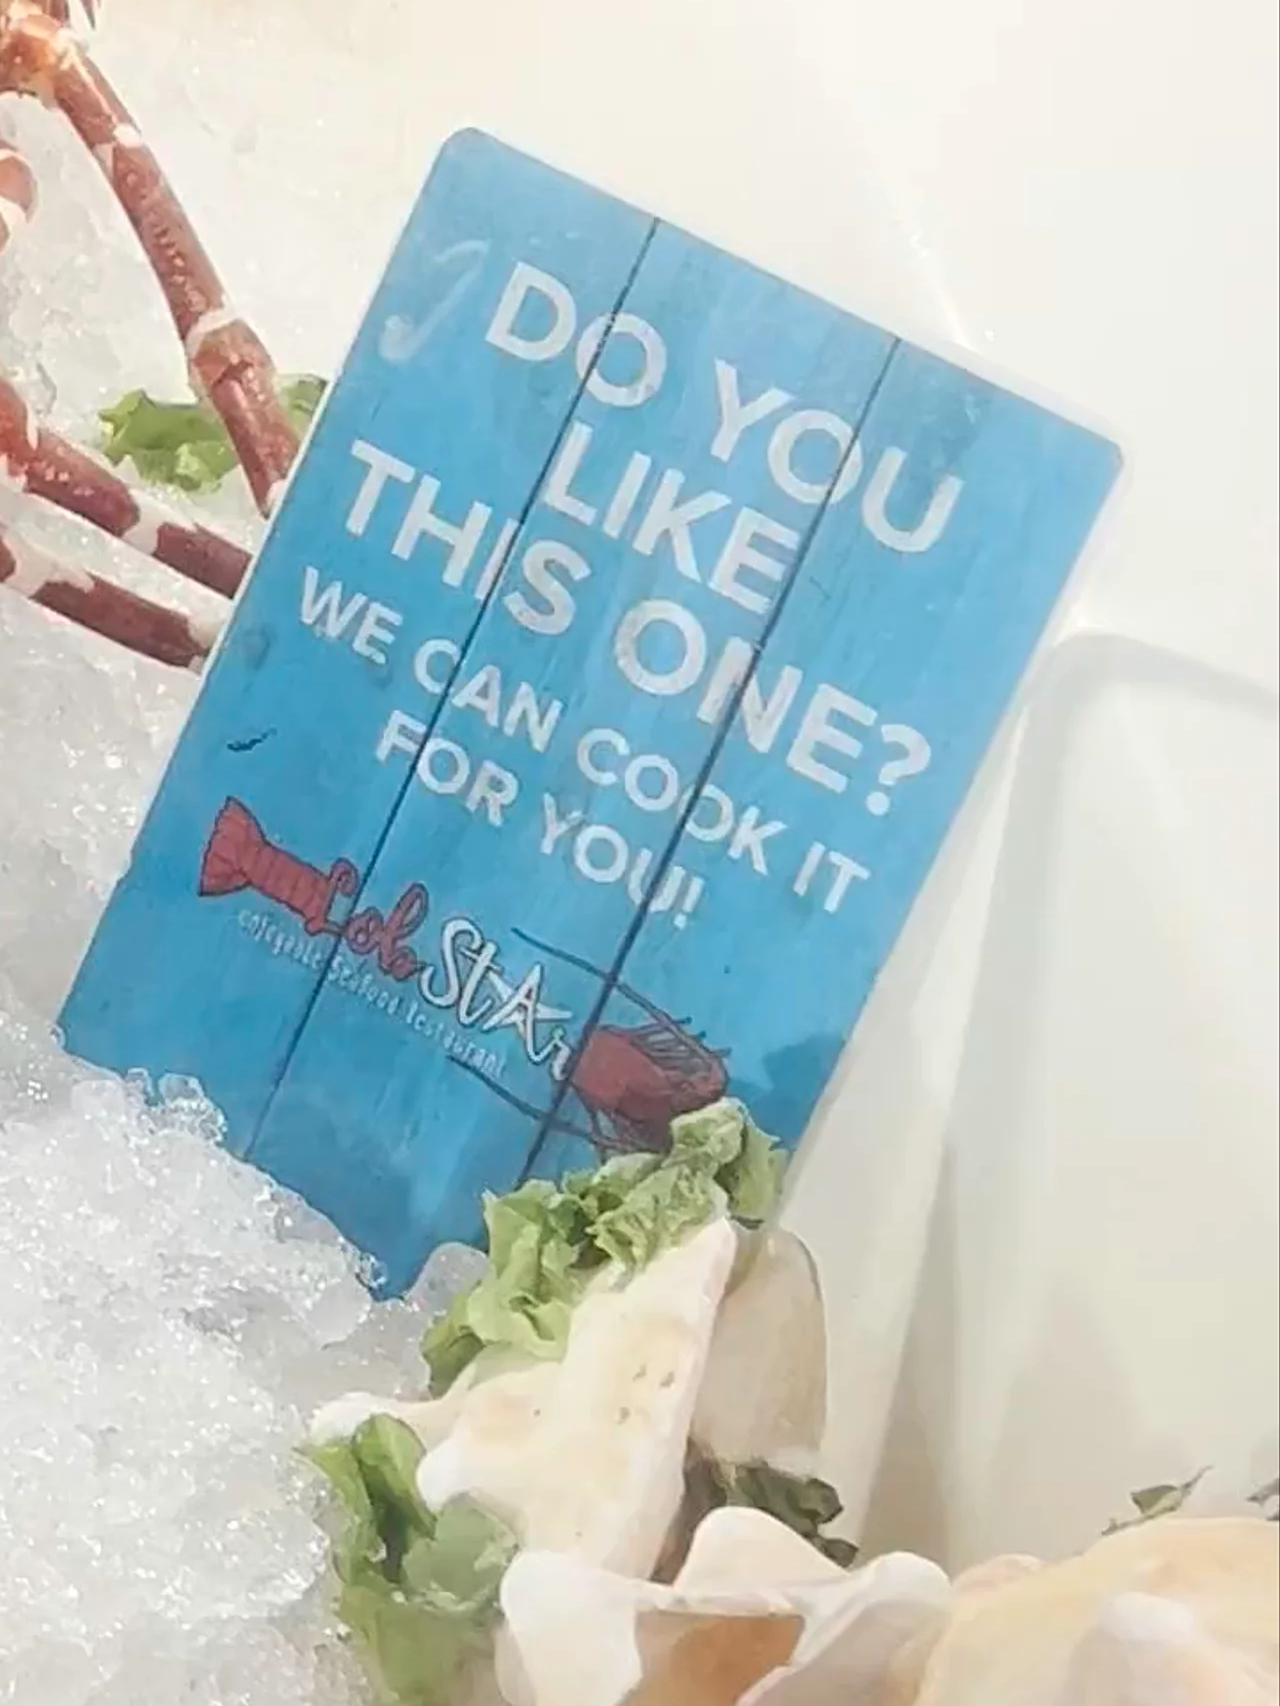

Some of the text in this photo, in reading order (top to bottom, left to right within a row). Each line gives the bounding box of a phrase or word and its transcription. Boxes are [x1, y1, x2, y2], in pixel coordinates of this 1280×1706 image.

[485, 261, 964, 553] DO YOU
[543, 422, 800, 614] LIKE
[298, 565, 870, 914] WE CAN COOK IT
[345, 439, 932, 817] THIS ONE?
[376, 709, 706, 929] FOR YOU!
